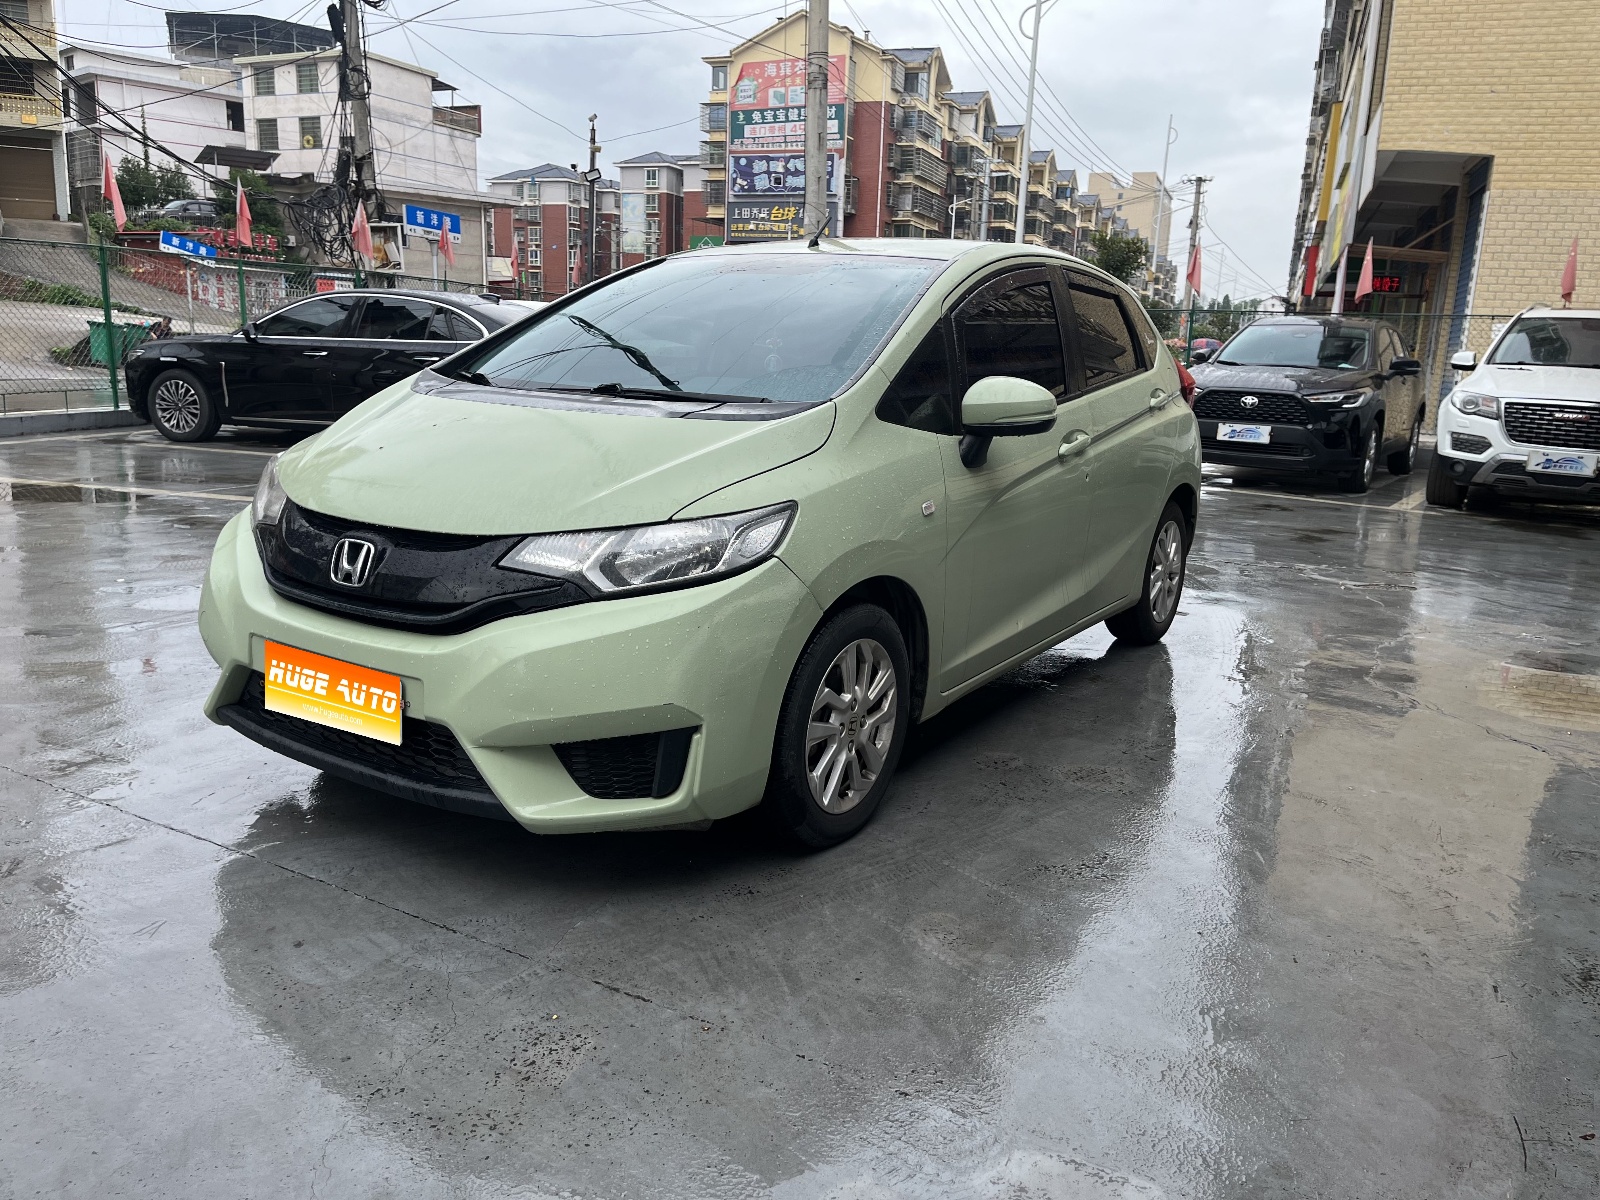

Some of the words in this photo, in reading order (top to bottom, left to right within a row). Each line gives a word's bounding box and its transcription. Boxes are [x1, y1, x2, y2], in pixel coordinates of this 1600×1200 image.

[751, 106, 837, 124] 兔宝宝健材
[416, 210, 451, 230] 新洋路
[171, 236, 207, 256] 新洋路
